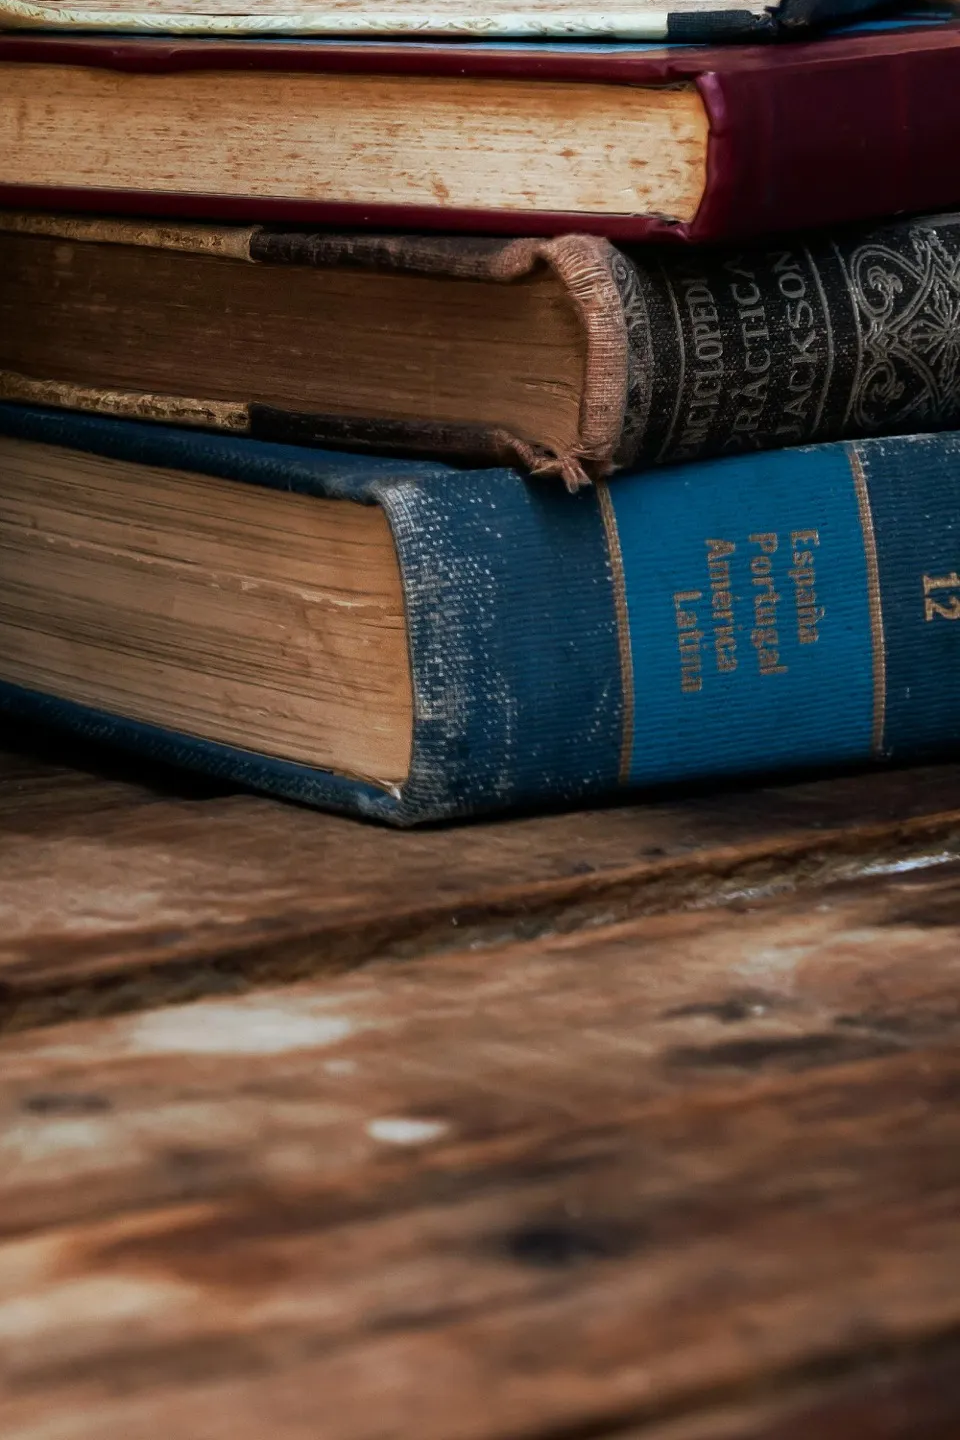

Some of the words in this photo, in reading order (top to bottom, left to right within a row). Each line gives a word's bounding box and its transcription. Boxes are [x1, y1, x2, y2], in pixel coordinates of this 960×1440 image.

[674, 258, 724, 457] NCICLOPEDI
[766, 250, 818, 439] JACKSON
[673, 590, 707, 693] Latina
[748, 532, 789, 676] Portugal
[788, 528, 825, 645] España
[923, 572, 960, 621] 12
